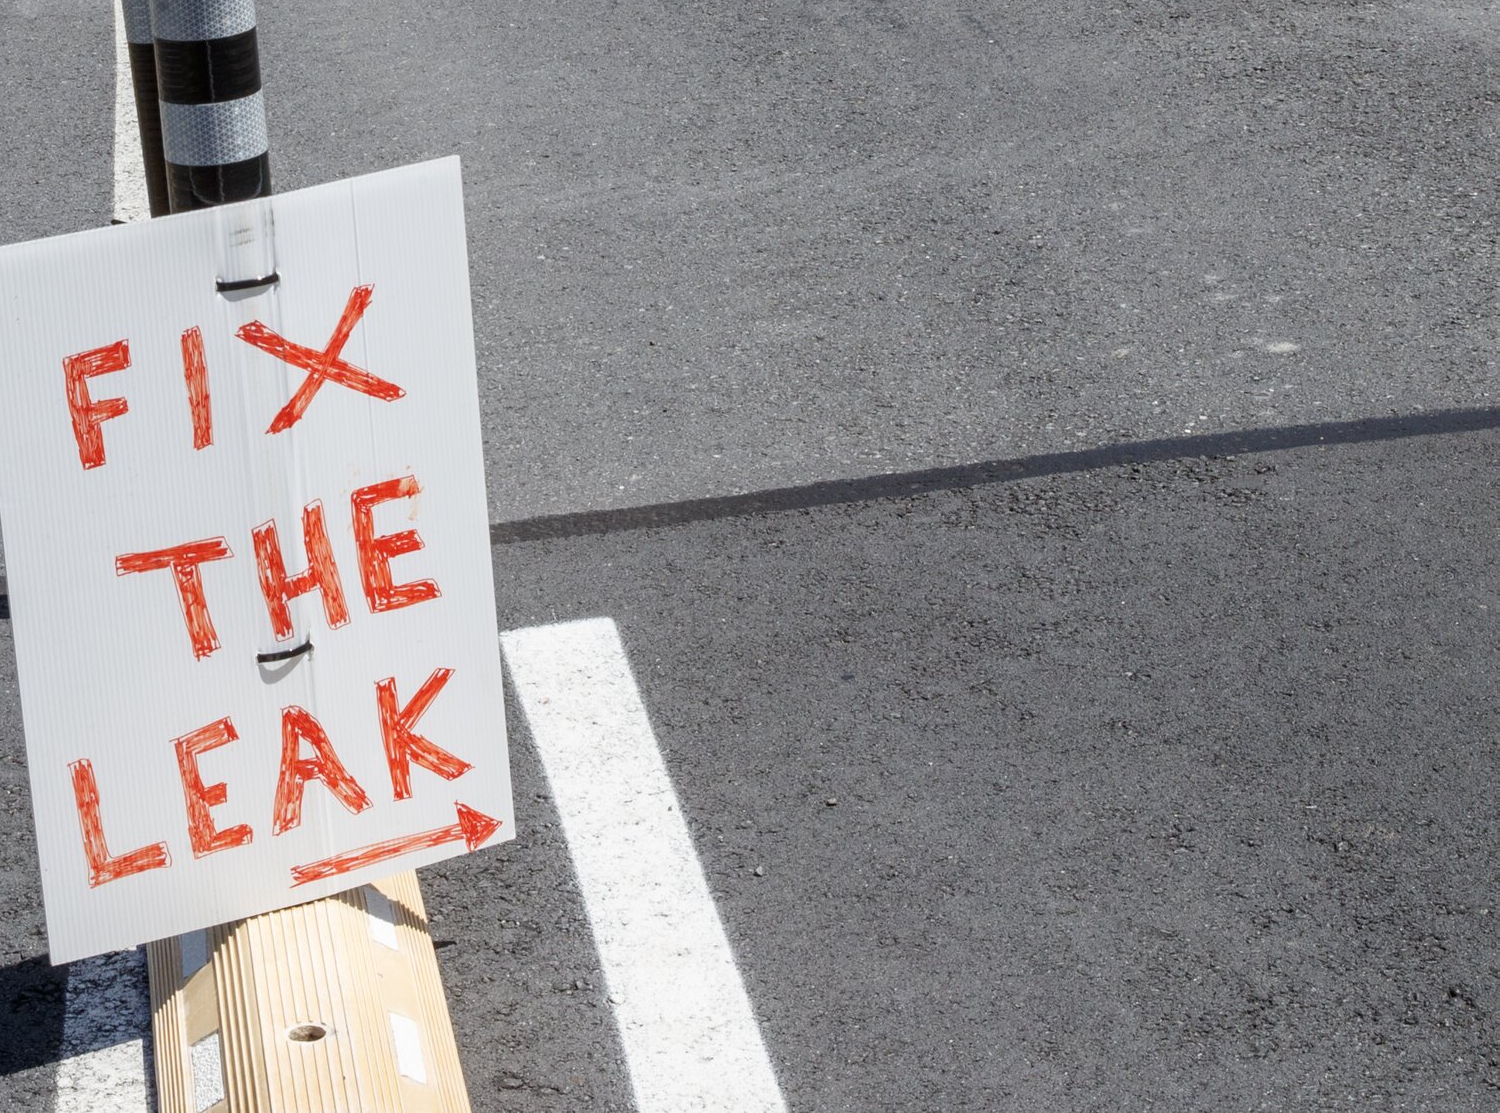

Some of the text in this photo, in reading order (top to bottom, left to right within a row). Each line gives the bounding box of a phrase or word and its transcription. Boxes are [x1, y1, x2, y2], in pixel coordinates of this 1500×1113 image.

[61, 284, 407, 472] FIX
[114, 476, 441, 662] THE
[67, 667, 475, 889] LEAK
